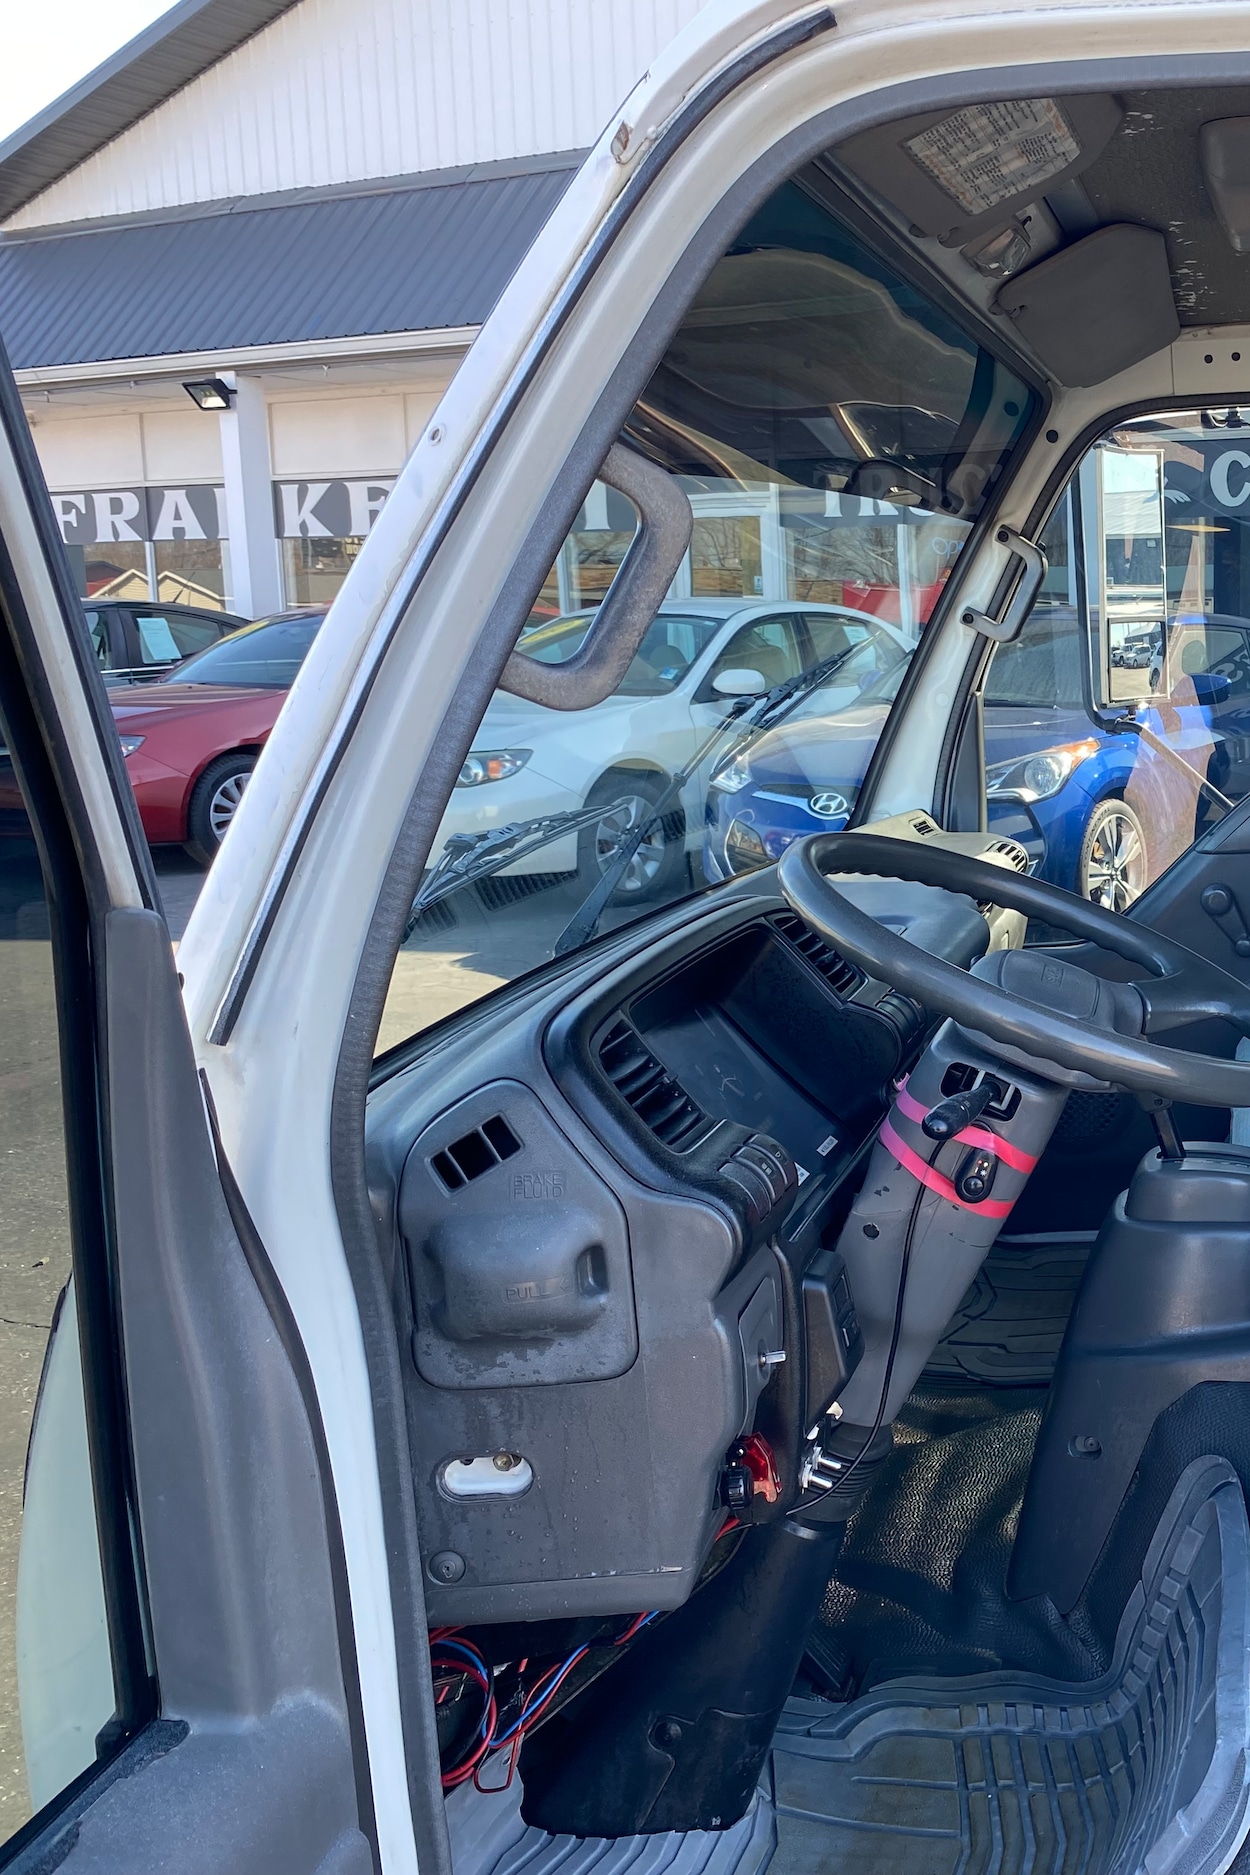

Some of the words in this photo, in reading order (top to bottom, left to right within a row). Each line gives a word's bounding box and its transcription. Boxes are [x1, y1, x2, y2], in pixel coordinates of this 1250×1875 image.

[513, 1173, 562, 1187] BRAKE
[513, 1186, 564, 1199] FLUID
[505, 1284, 551, 1300] PULL
